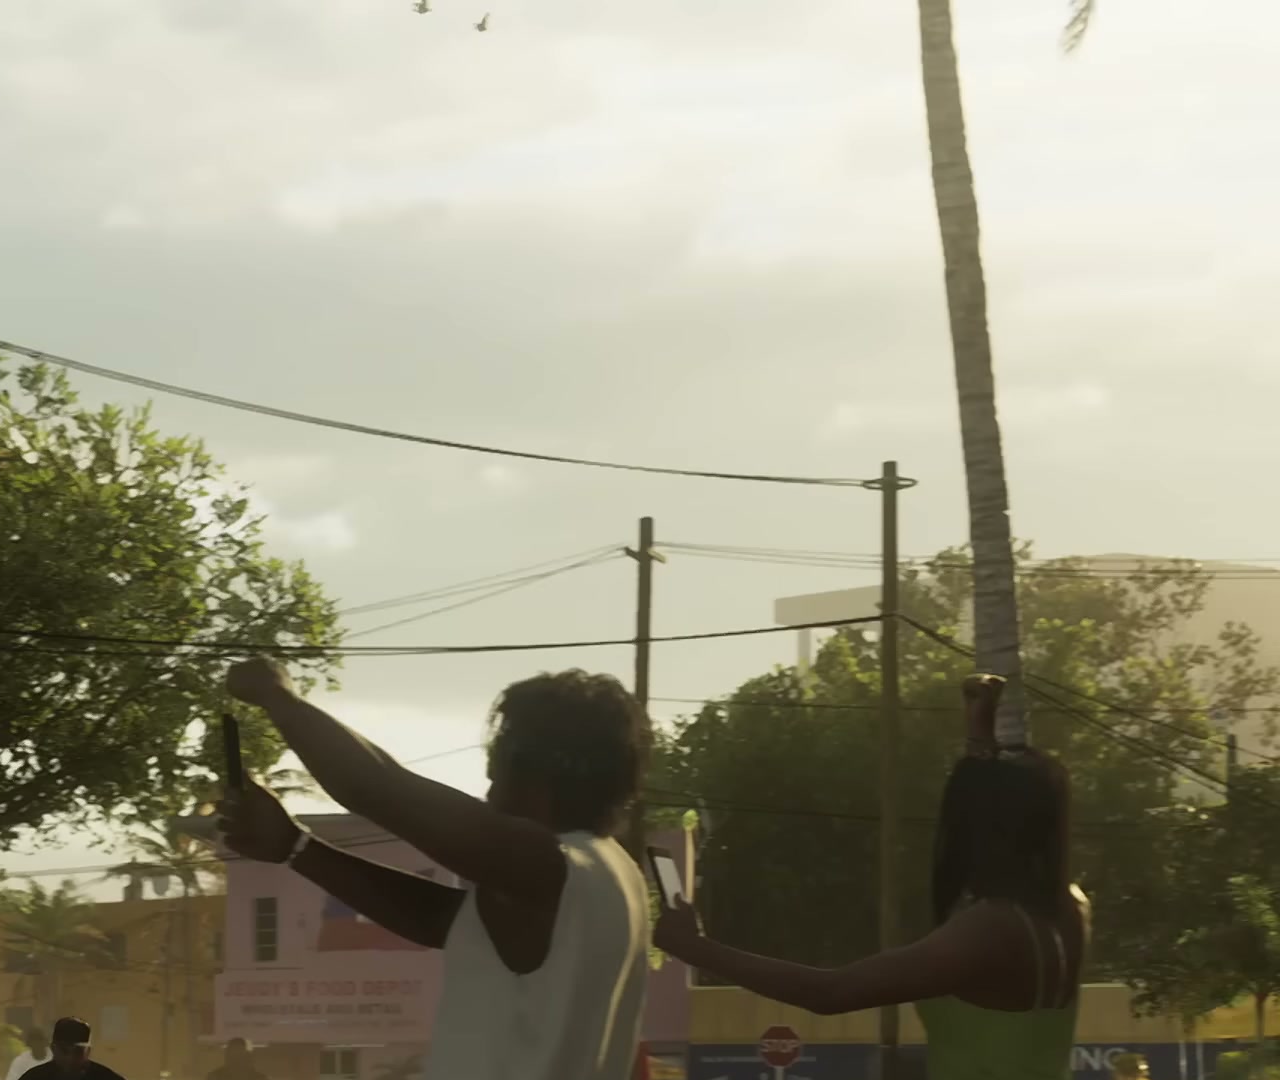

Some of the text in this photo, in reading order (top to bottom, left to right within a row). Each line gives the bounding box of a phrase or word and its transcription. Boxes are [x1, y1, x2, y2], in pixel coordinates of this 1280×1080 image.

[306, 980, 356, 997] FOOD
[362, 979, 423, 996] DEPOT
[760, 1039, 800, 1053] STOP
